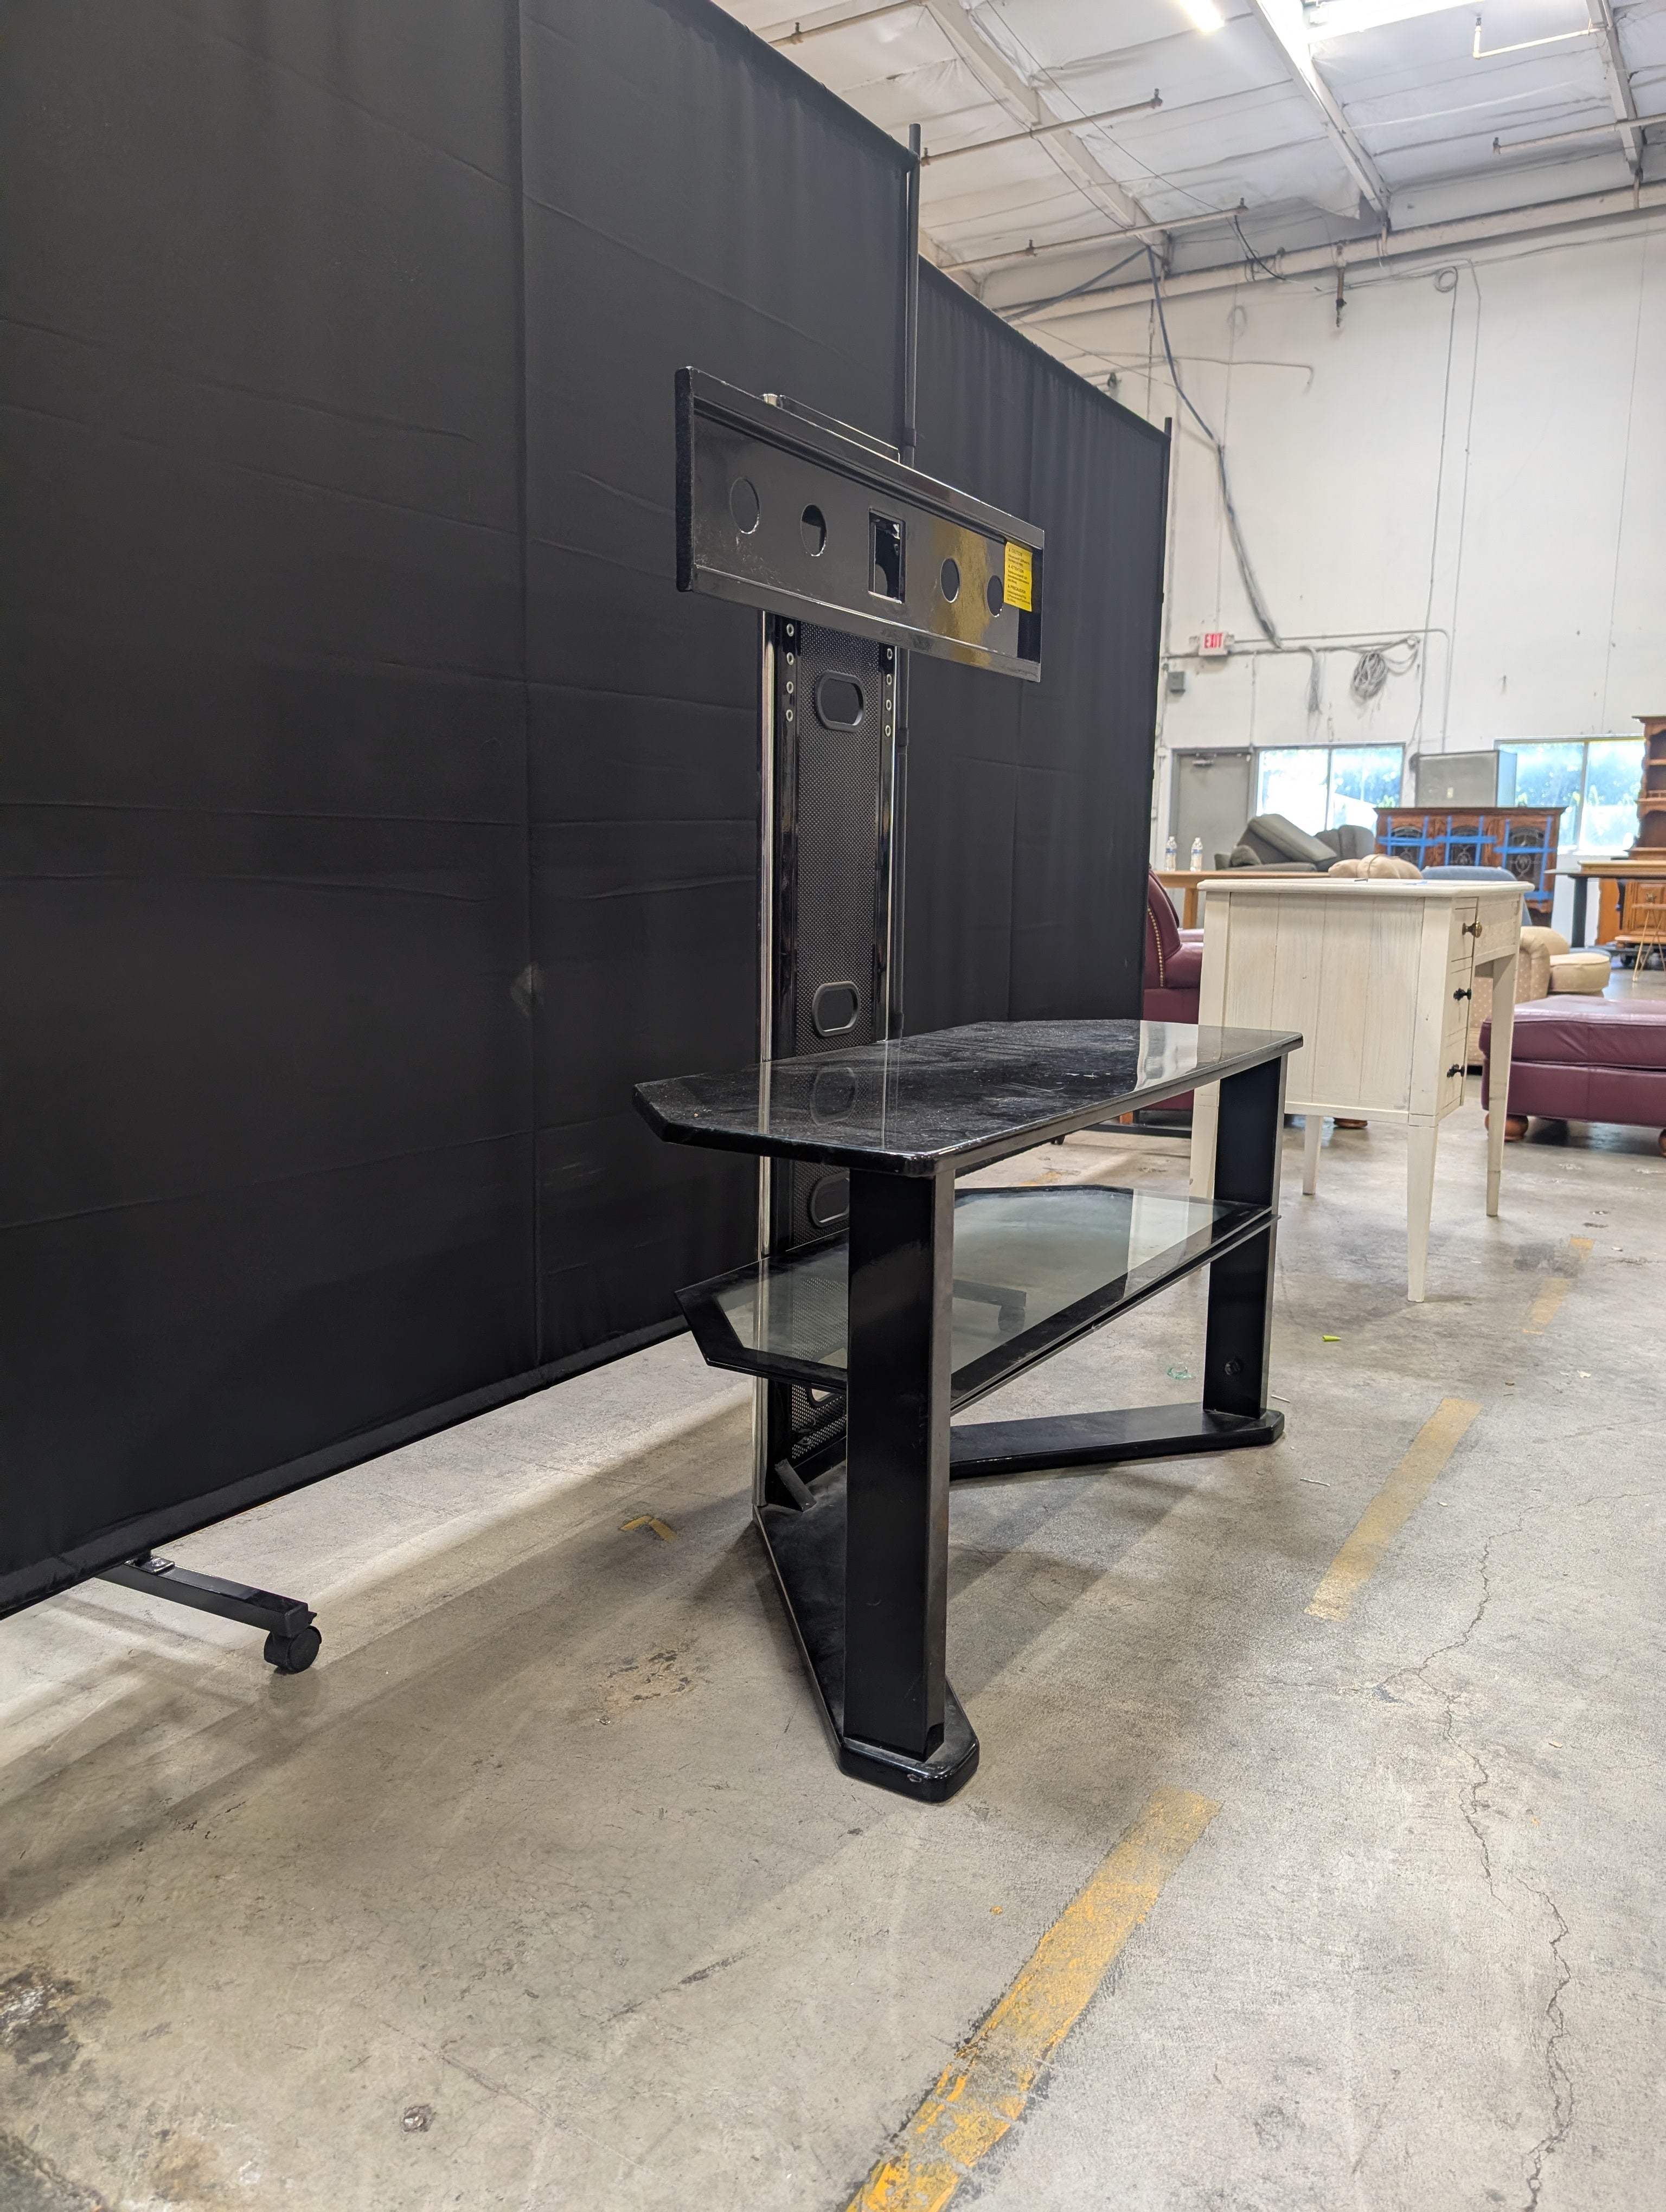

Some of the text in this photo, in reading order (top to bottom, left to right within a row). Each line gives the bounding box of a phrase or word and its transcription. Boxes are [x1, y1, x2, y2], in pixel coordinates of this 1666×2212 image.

[1011, 548, 1022, 556] CAUTION
[1011, 565, 1024, 574] ATTENTION
[1204, 633, 1223, 649] EXIT
